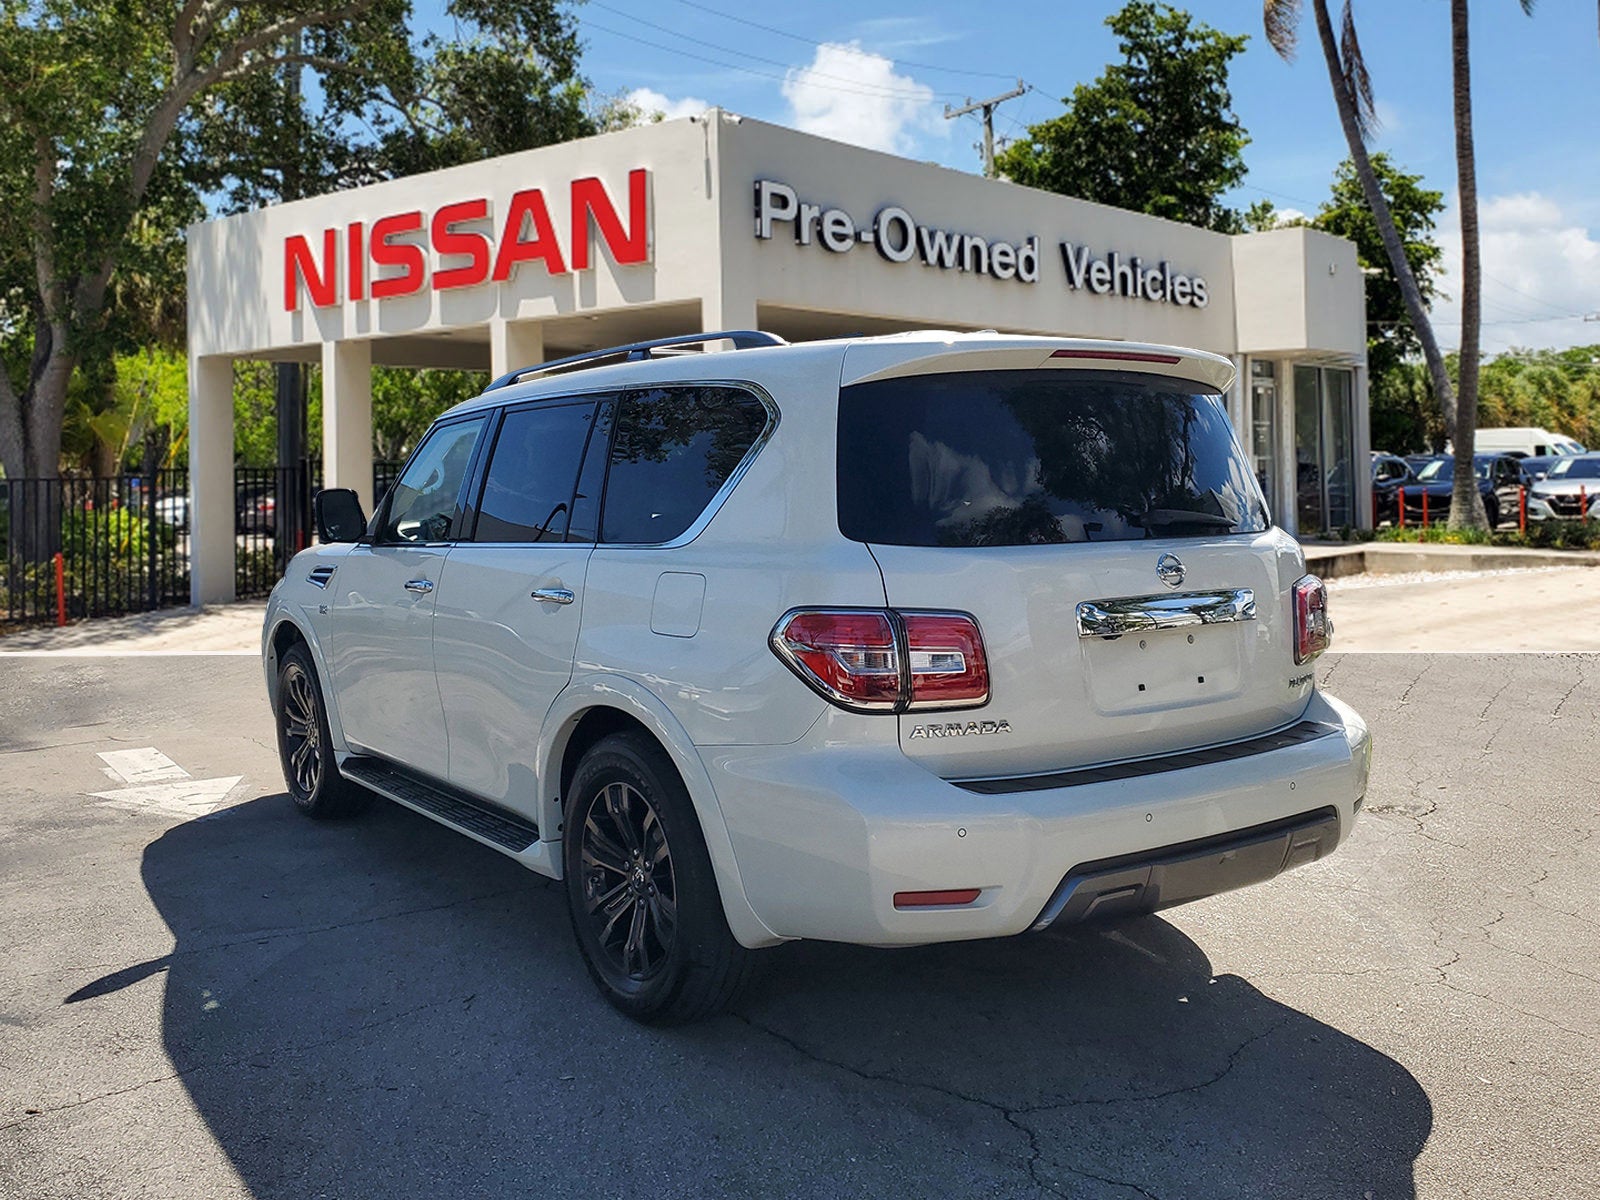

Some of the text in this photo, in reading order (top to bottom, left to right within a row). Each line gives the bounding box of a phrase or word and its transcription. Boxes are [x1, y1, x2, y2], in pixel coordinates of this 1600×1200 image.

[284, 168, 650, 312] NISSAN
[754, 179, 1209, 308] Pre-Owned Vehicles
[909, 719, 1013, 740] ARMADA
